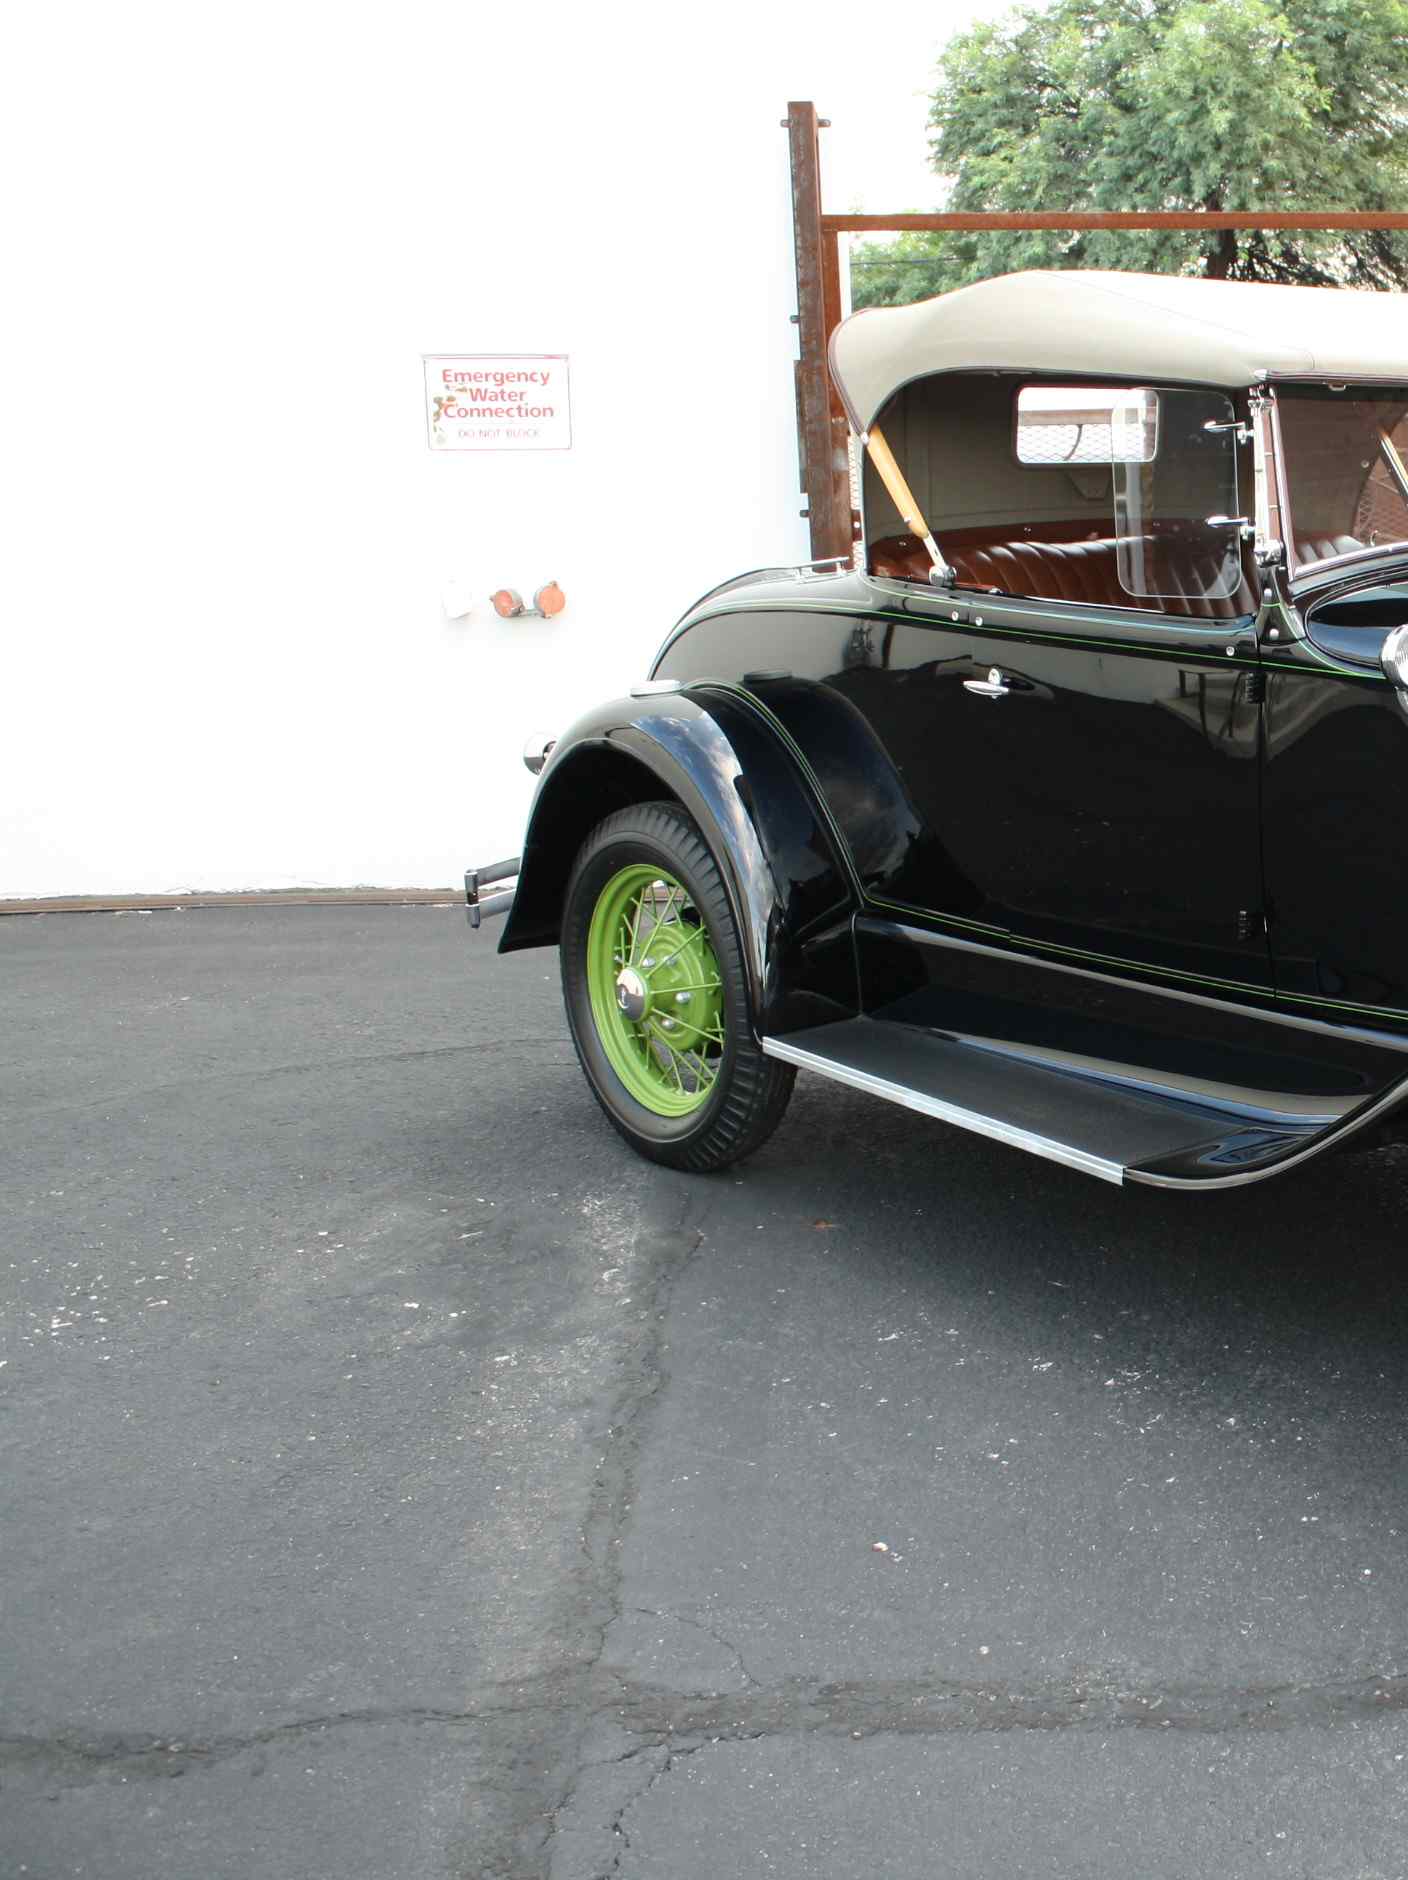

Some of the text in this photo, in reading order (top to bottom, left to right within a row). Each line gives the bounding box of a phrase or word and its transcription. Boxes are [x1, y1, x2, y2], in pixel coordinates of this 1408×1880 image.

[442, 368, 550, 386] Emergency
[469, 388, 527, 402] Water
[443, 402, 554, 418] Connection
